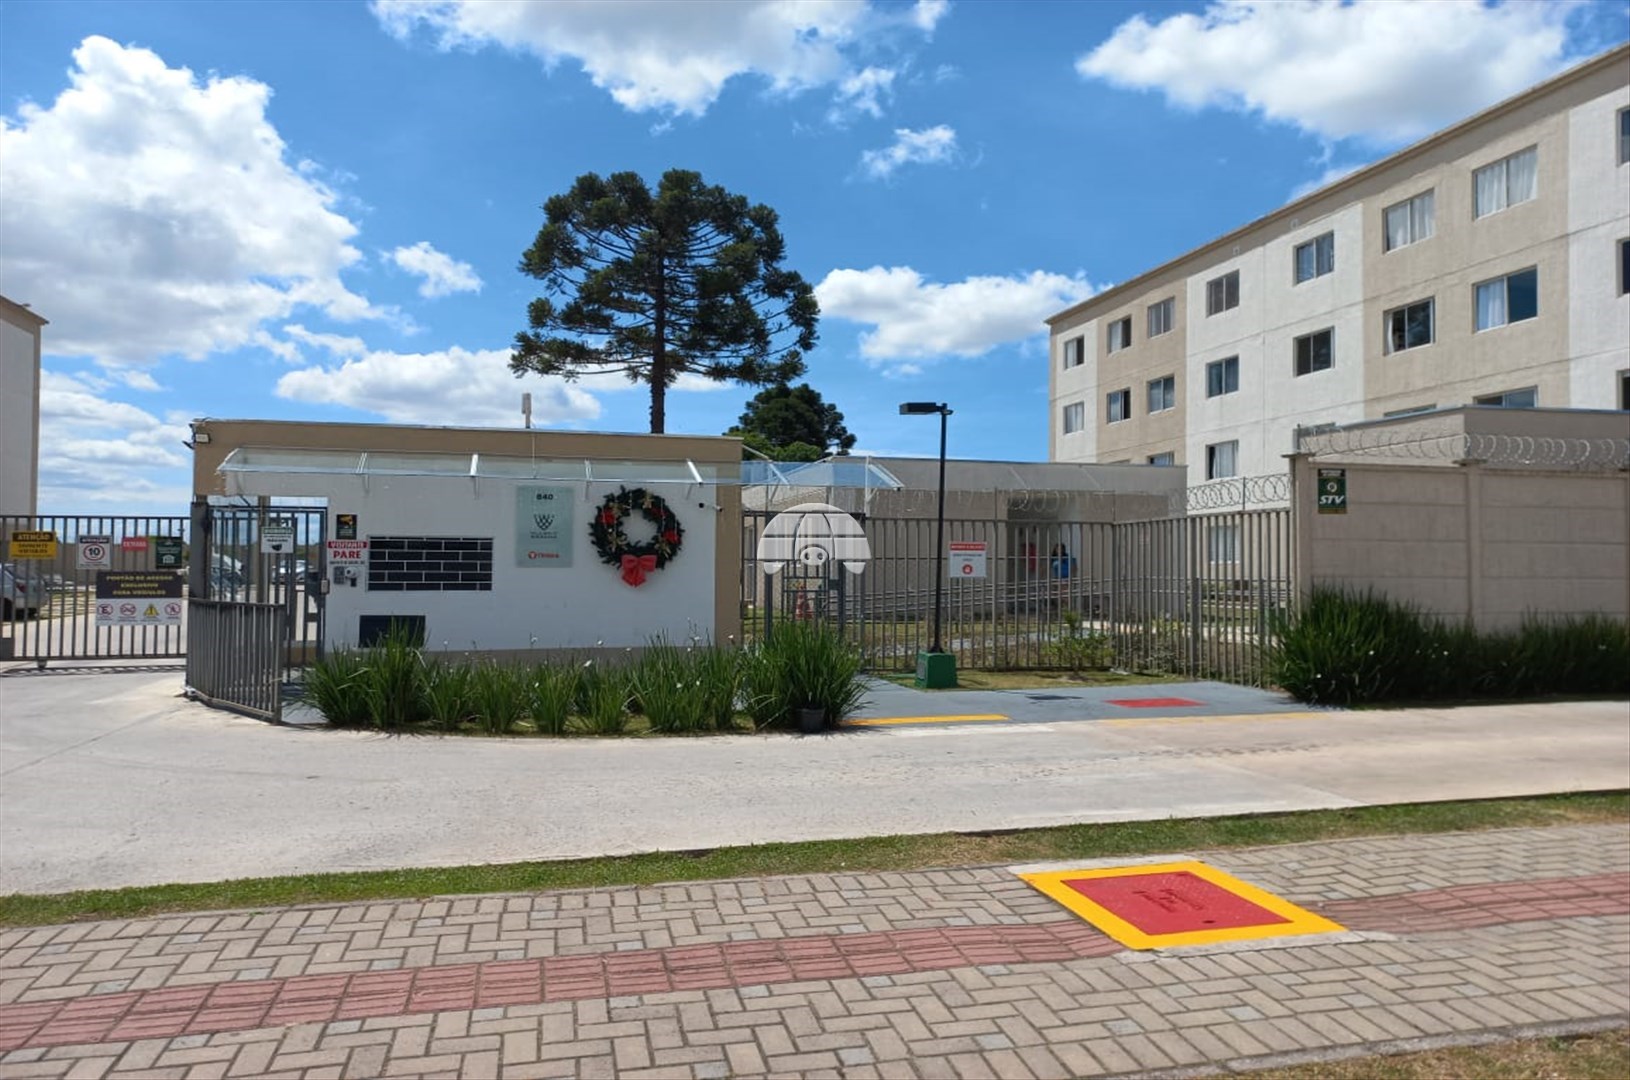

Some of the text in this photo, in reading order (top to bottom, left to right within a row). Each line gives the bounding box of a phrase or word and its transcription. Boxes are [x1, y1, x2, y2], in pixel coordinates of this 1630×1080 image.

[1319, 495, 1345, 504] STV
[88, 547, 101, 556] 10
[333, 550, 361, 558] PARE
